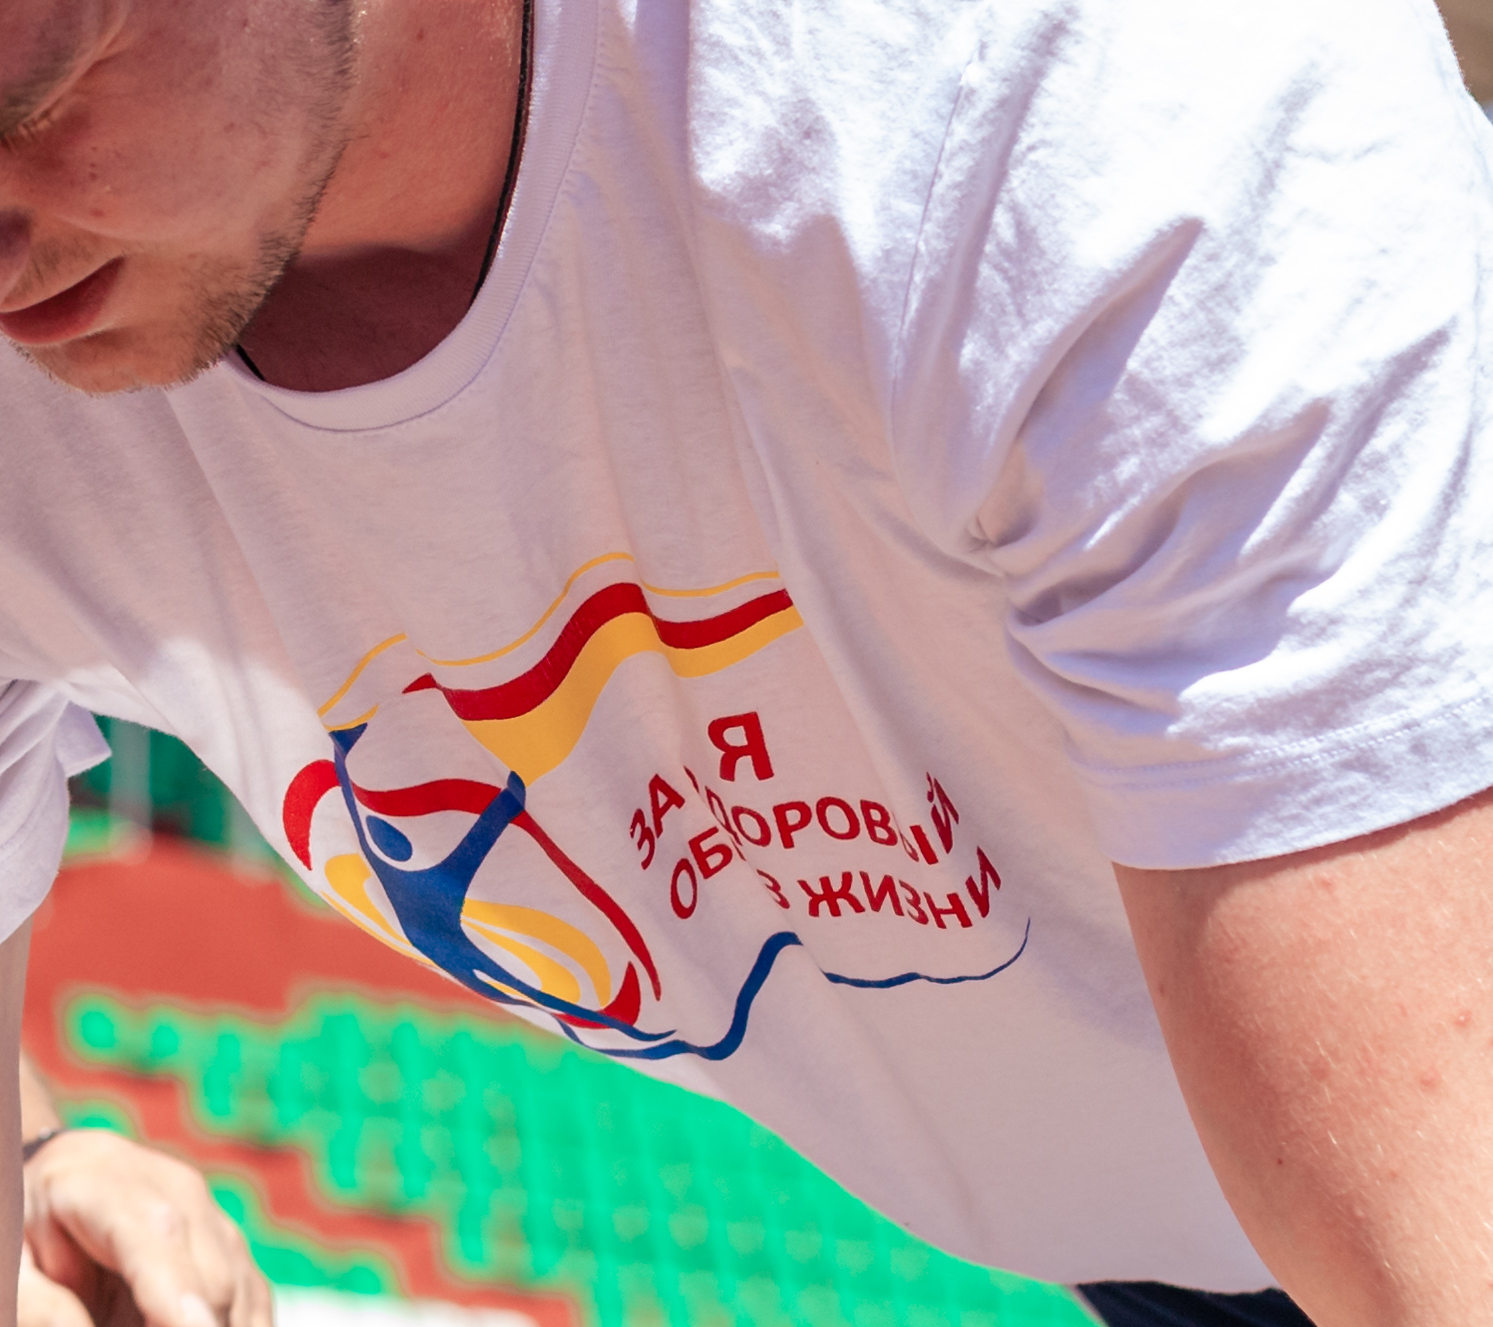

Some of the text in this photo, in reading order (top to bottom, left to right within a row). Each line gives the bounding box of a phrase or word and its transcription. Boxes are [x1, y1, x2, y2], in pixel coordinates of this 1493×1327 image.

[707, 711, 775, 782] Я
[629, 765, 960, 870] ЗА ДОРОВЫЙ
[670, 826, 1002, 930] ОБЗ ЖИЗНИ
